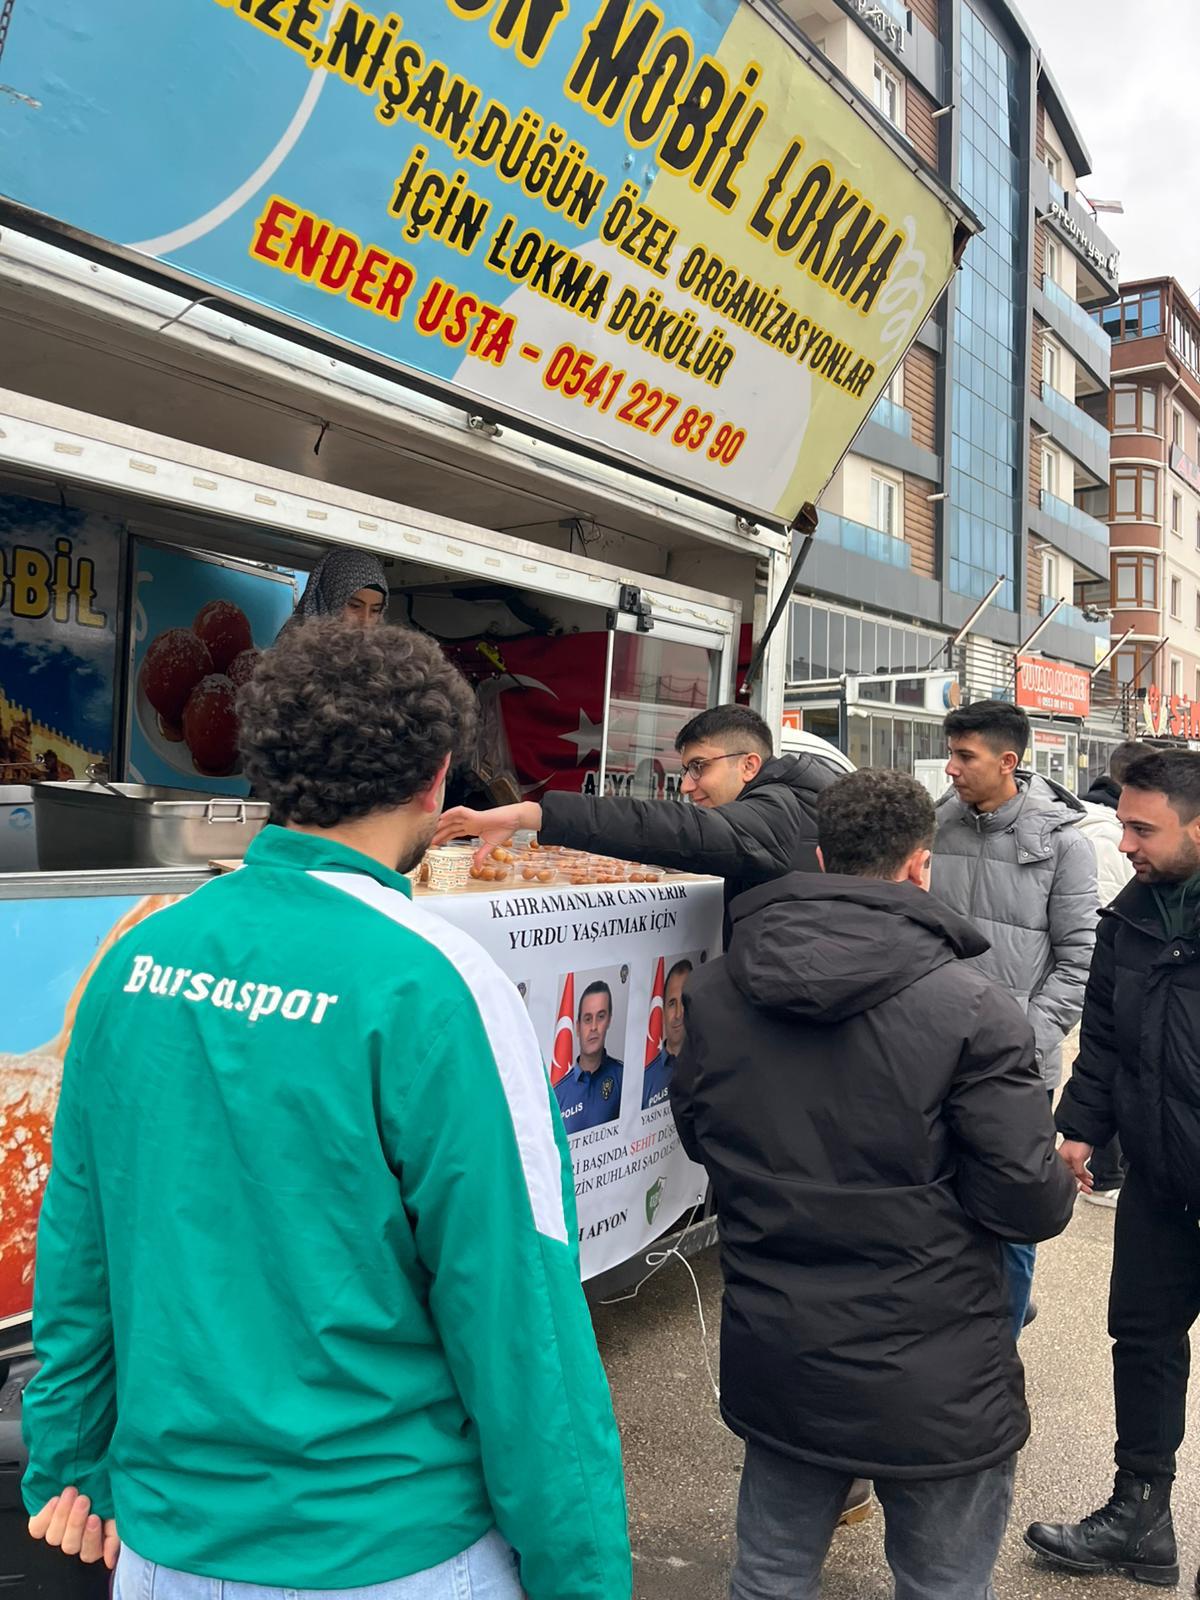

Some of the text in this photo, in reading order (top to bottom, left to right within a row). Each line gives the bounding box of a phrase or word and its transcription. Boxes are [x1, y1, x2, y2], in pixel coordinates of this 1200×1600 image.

[568, 0, 765, 210] MOBİL
[750, 141, 904, 314] LOKMA
[391, 149, 735, 386] İÇİN LOKMA DÖKÜLÜR
[602, 183, 679, 276] ÖZEL
[678, 246, 876, 398] ORGANİZASYONLAR
[253, 199, 414, 317] ENDER
[417, 281, 516, 363] USTA
[544, 346, 625, 411] 0541
[617, 382, 681, 434] 227
[673, 408, 713, 450] 83
[708, 424, 746, 465] 90
[0, 538, 107, 628] BİL
[489, 889, 617, 919] KAHRAMANLAR
[617, 888, 648, 905] CAN
[508, 908, 678, 950] YURDU YAŞATMAK İÇİN
[122, 954, 339, 1025] Bursaspor
[582, 1124, 620, 1147] KÜLÜNK
[582, 1145, 629, 1173] BAŞINDA
[595, 1160, 642, 1189] RUHLARI
[641, 1149, 661, 1171] ŞAD
[586, 1207, 629, 1240] AFYON
